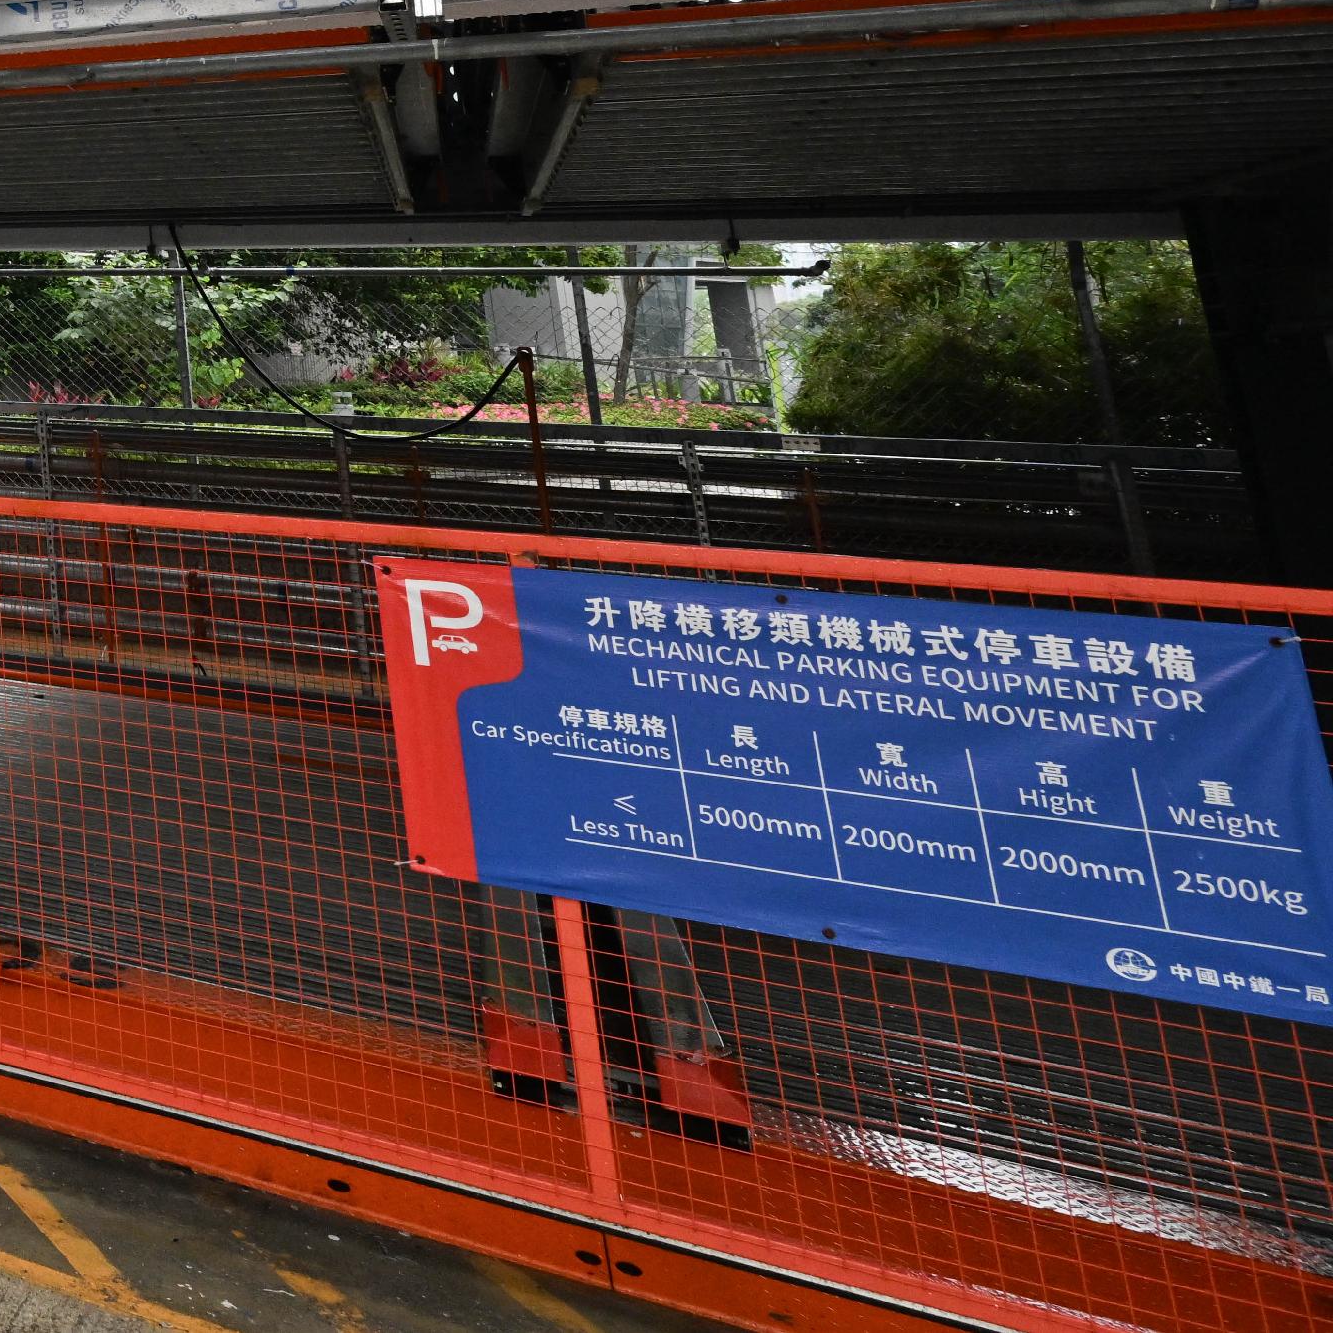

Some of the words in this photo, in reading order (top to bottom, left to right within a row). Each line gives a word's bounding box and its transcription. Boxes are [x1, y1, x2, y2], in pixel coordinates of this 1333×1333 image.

[405, 580, 483, 666] P
[588, 634, 771, 670] MECHANICAL
[777, 650, 917, 685] PARKING
[922, 662, 1123, 704] EQUIPMENT
[1131, 682, 1204, 713] FOR
[558, 704, 669, 738] 停車規格
[631, 667, 742, 700] LIFTING
[749, 678, 811, 705] AND
[817, 686, 956, 721] LATERAL
[963, 701, 1158, 741] MOVEMENT
[472, 720, 509, 740] Car
[513, 725, 671, 762] Specifications
[731, 725, 760, 750] 長
[706, 749, 791, 778] Length
[878, 743, 908, 768] 寬
[859, 768, 939, 796] Width
[1037, 761, 1068, 788] 高
[1019, 786, 1097, 817] Hight
[1200, 780, 1232, 808] 重
[570, 814, 619, 839] Less
[625, 821, 684, 849] Than
[699, 804, 824, 841] 5000mm
[1169, 807, 1280, 839] Weight
[842, 823, 978, 864] 2000mm
[999, 845, 1146, 887] 2000mm
[1174, 869, 1308, 917] 2500kg
[1170, 963, 1330, 1005] 中國中鐵一局
